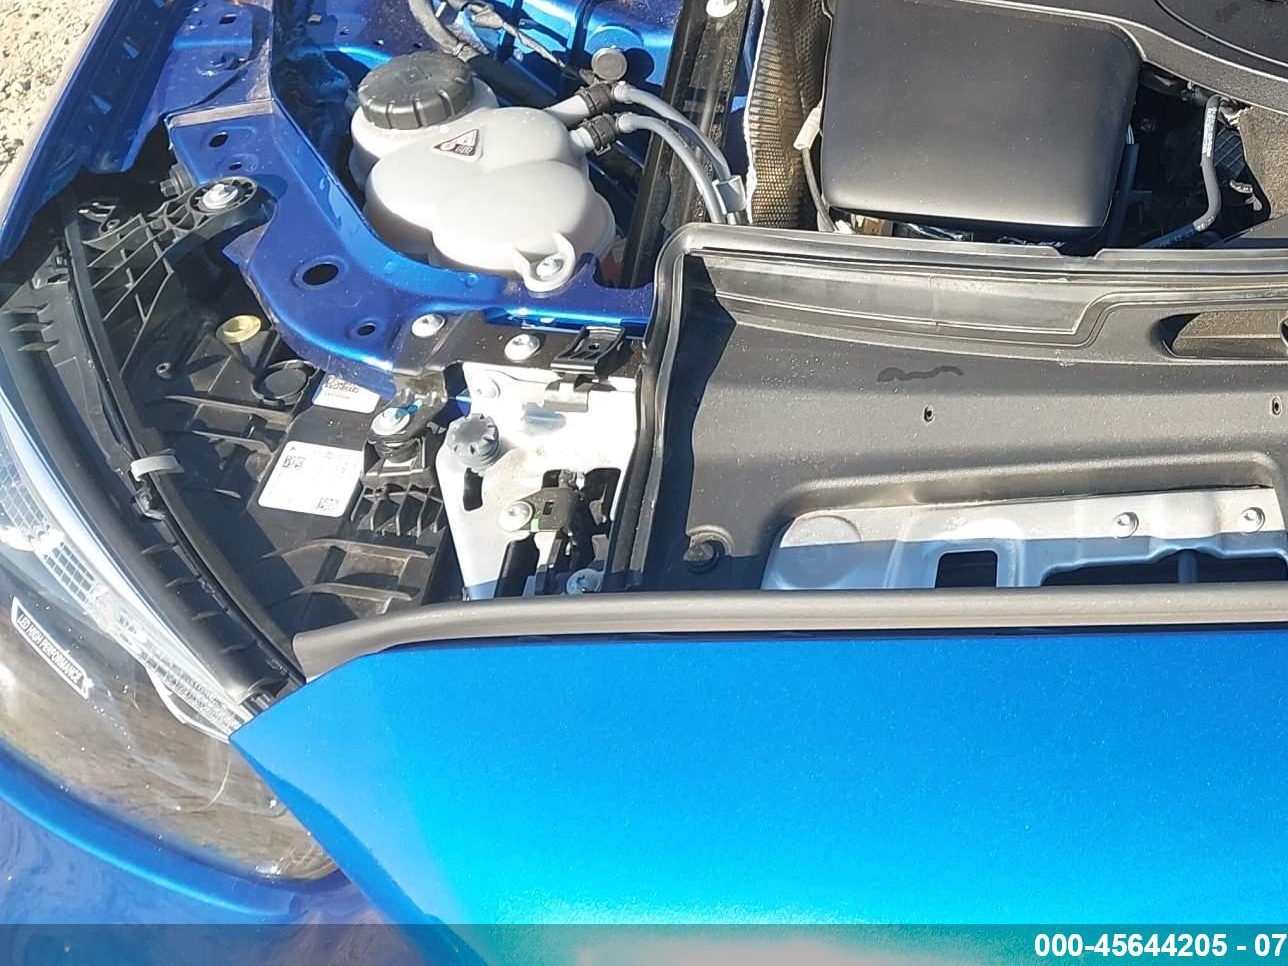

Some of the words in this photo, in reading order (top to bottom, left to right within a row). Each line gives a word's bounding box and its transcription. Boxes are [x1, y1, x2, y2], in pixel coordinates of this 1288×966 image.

[17, 614, 31, 630] LED
[26, 626, 43, 645] HIGH
[38, 639, 83, 684] PERFORMANCE
